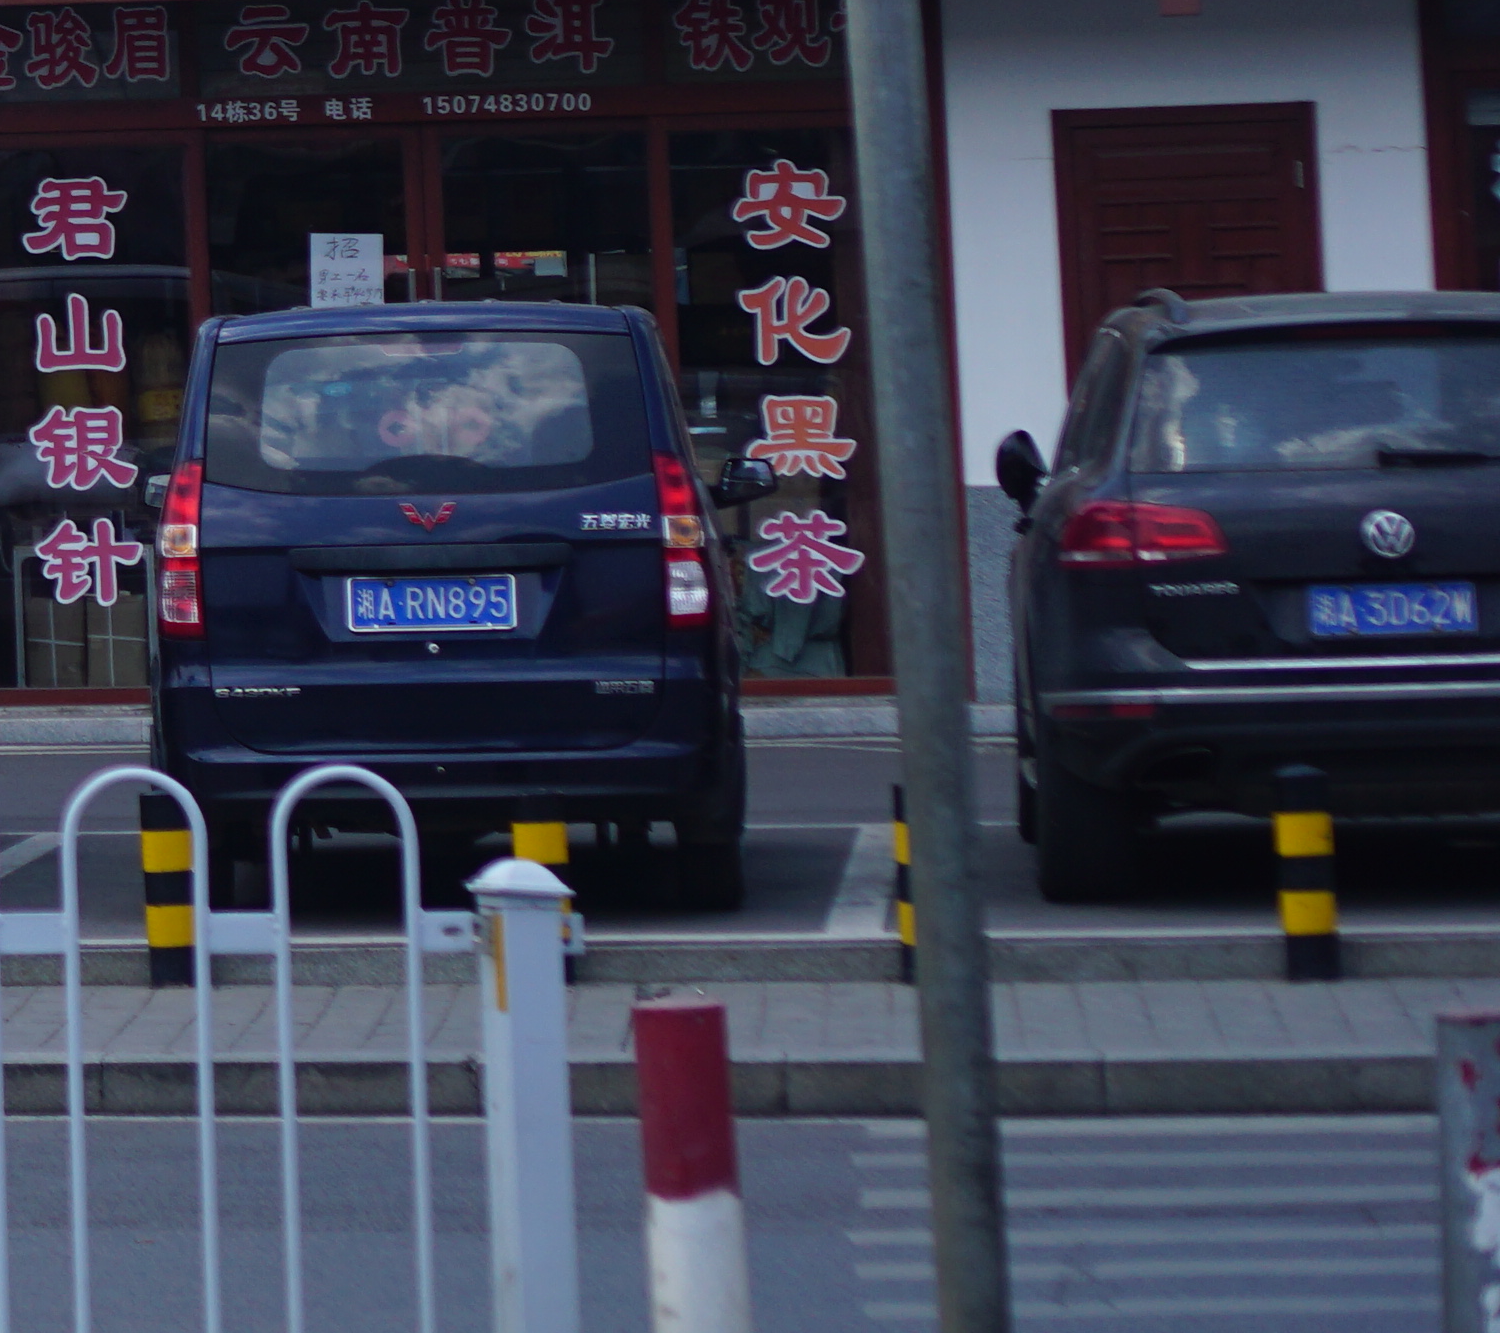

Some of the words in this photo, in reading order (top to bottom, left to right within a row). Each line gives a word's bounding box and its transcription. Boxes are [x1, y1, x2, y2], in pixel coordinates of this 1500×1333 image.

[195, 99, 300, 125] 14栋36号
[323, 98, 374, 122] 电话
[422, 92, 593, 117] 15074830700
[324, 236, 360, 261] 招
[21, 175, 143, 606] 君山银针
[731, 158, 865, 605] 安化黑茶
[357, 585, 508, 620] 湘A·RN895
